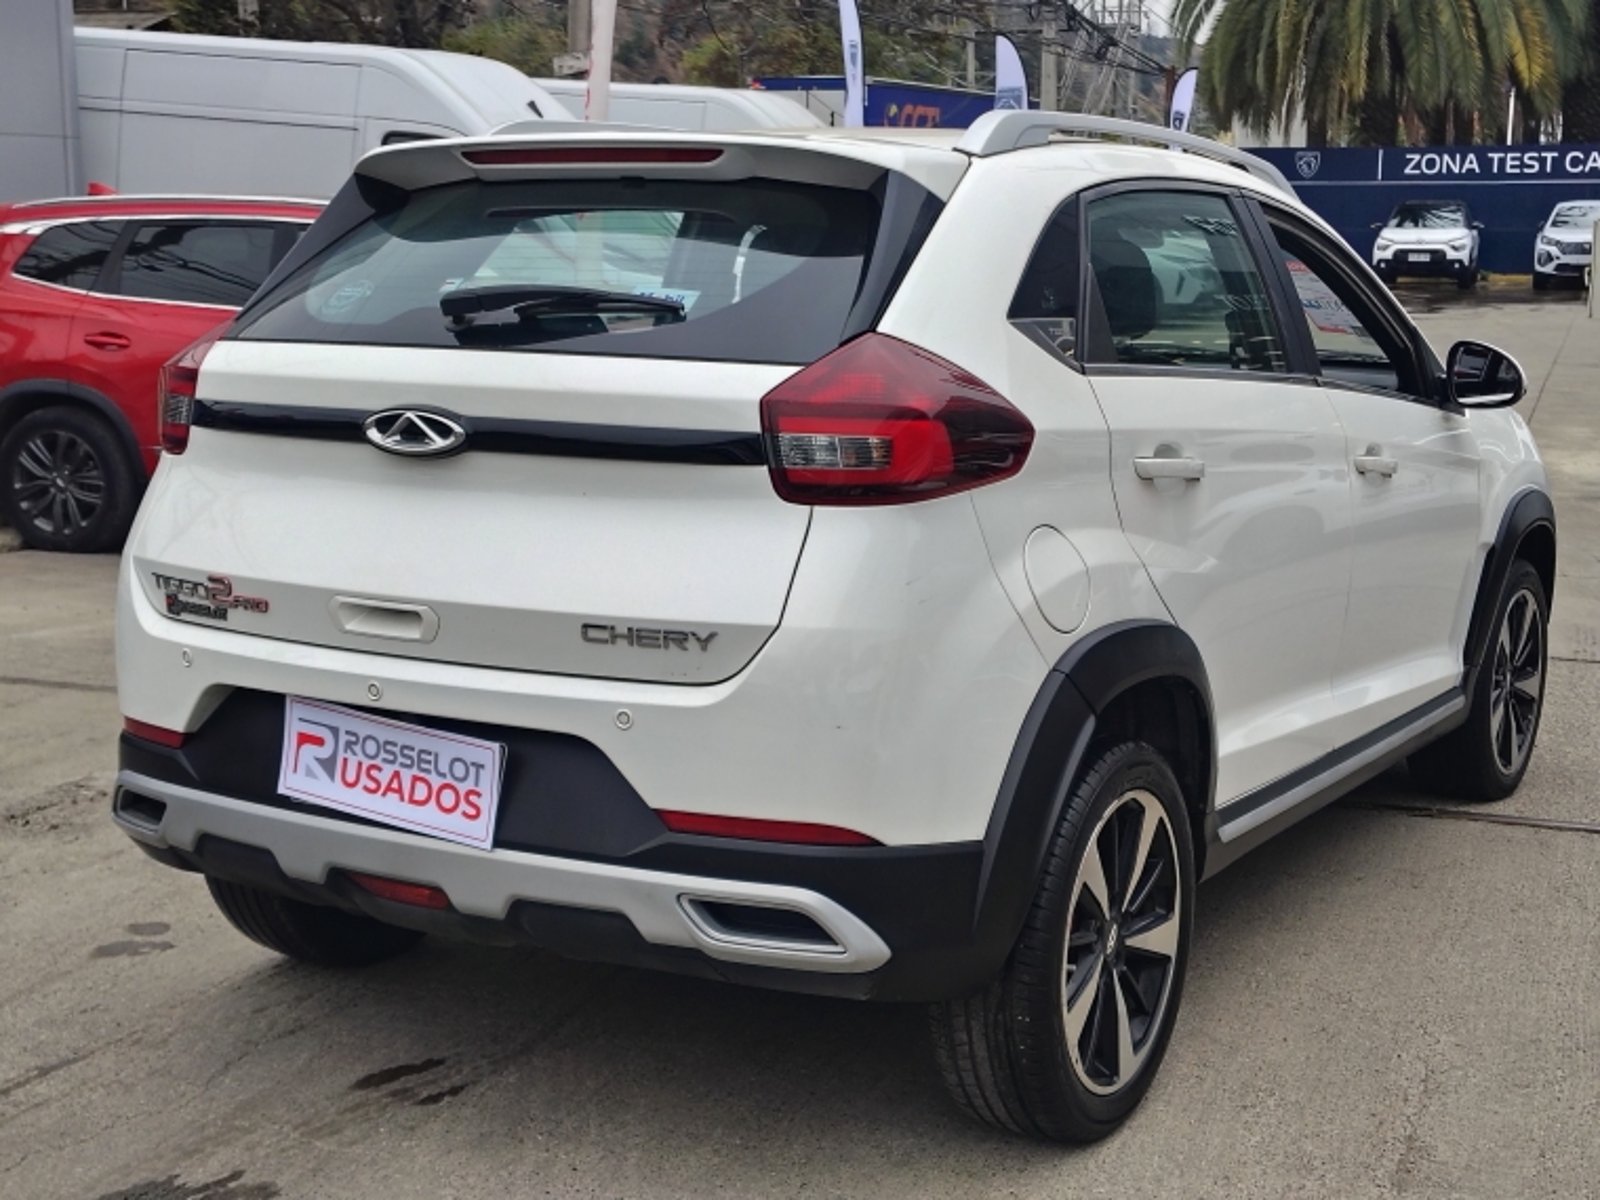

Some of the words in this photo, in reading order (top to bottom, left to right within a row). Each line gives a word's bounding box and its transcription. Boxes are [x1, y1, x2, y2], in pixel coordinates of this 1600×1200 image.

[1403, 153, 1480, 174] ZONA
[1487, 152, 1558, 174] TEST
[581, 622, 719, 652] CHERY
[344, 729, 485, 788] ROSSELOT
[340, 756, 482, 821] USADOS
